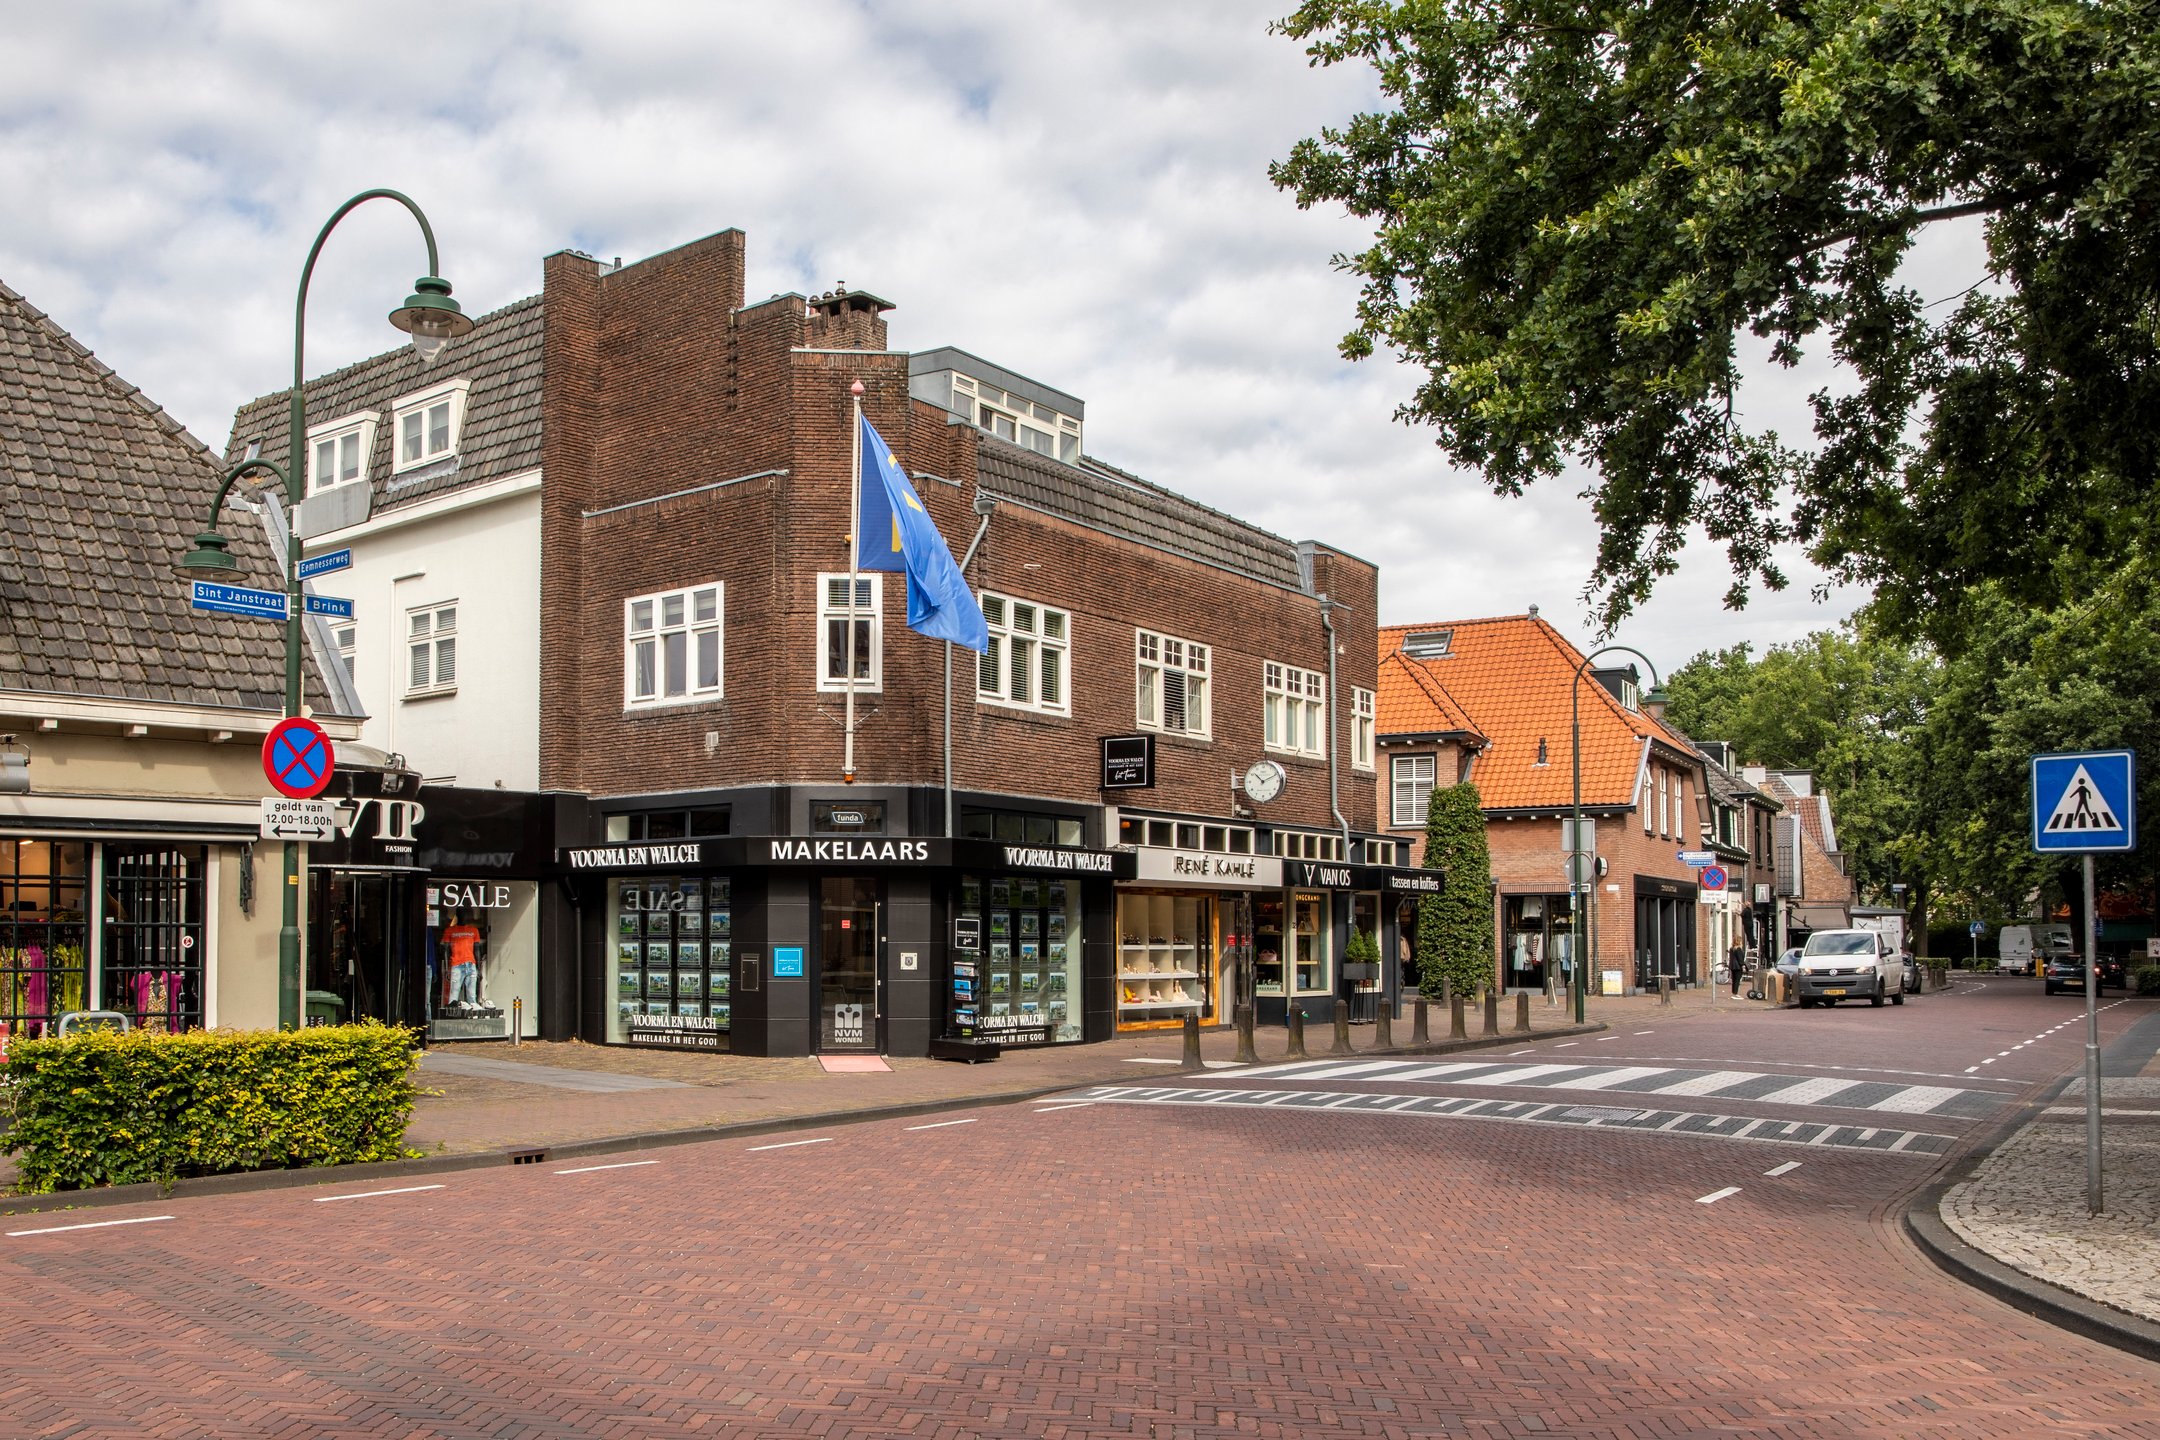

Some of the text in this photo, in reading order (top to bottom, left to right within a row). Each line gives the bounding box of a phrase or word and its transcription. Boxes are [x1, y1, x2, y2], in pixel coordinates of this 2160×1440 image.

[301, 553, 349, 573] Eemnesserweg
[197, 586, 283, 607] Sint Janstraat
[313, 600, 346, 613] Brink
[275, 802, 323, 812] geldt van
[265, 814, 332, 826] 12.00-18.00h
[322, 797, 425, 841] VIP
[837, 814, 858, 822] funda
[385, 845, 412, 853] FASHION
[569, 844, 700, 868] VOORMA EN WALCH
[771, 841, 928, 860] MAKELAARS
[1004, 847, 1113, 872] VOORMA EN WALCH
[1320, 868, 1338, 885] VAN
[1340, 869, 1350, 886] OS
[1392, 876, 1439, 891] tassen en koffers
[443, 884, 511, 908] SALE
[633, 1014, 717, 1029] VOORMA EN WALCH
[977, 1014, 1044, 1028] ORMA EN WALCH
[633, 1034, 717, 1046] MAKELAARS IN HET GOOI
[1017, 1034, 1028, 1042] HET
[1030, 1033, 1045, 1041] GOOI
